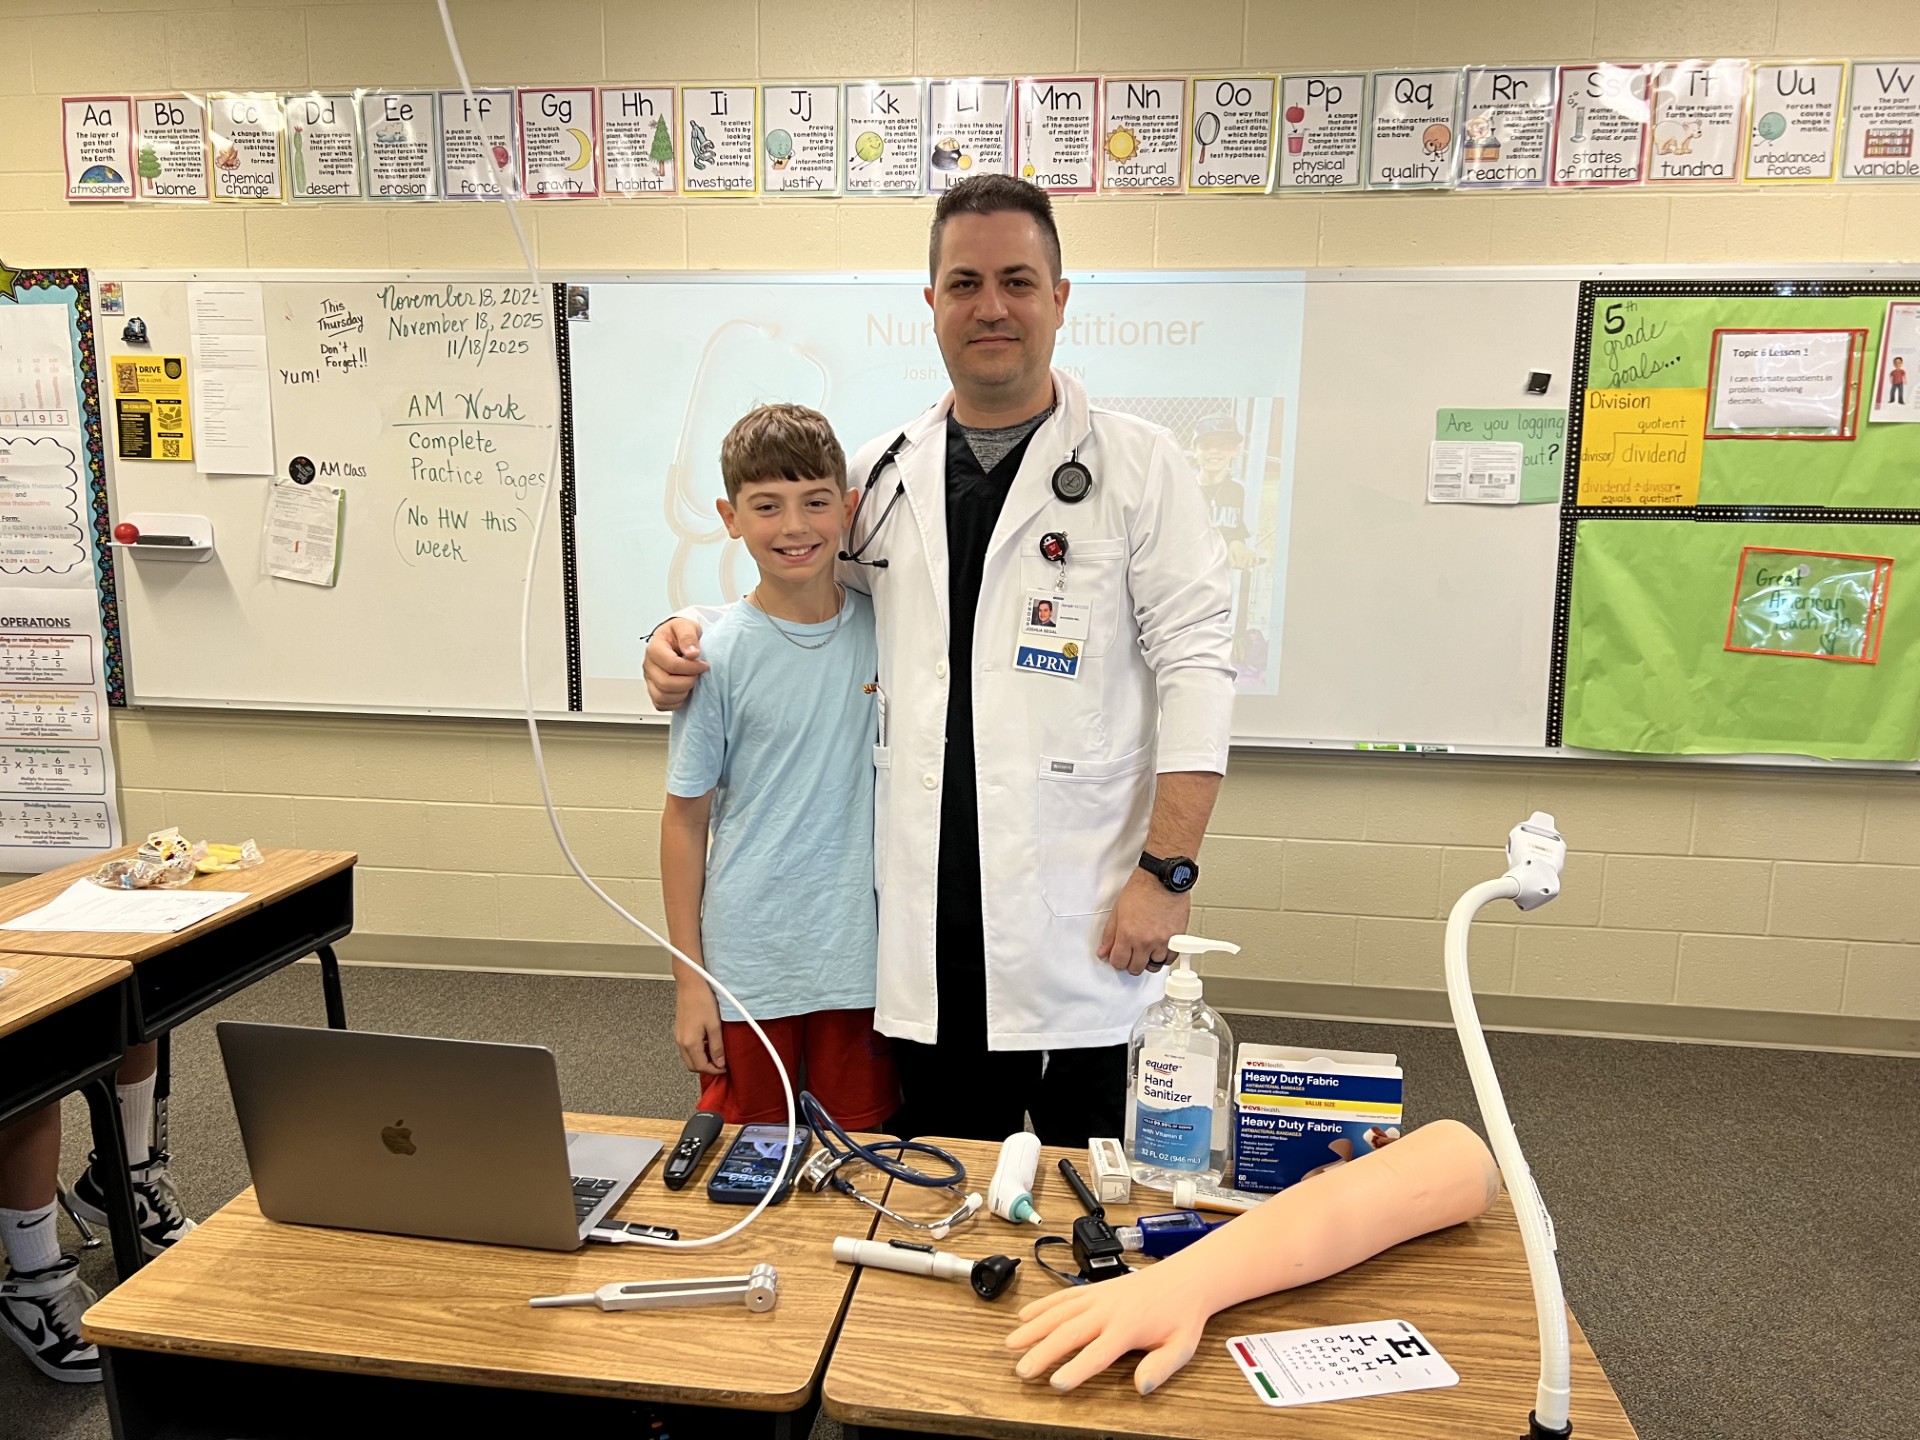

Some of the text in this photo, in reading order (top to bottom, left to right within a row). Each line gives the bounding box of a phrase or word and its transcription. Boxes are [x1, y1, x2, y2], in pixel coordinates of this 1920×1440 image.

[1492, 74, 1528, 100] Rr
[1686, 70, 1718, 97] Tt
[1777, 69, 1815, 96] Uu
[1876, 67, 1915, 93] Vv
[871, 89, 900, 114] Kk
[957, 87, 979, 112] Ll
[1031, 85, 1081, 110] Mm
[1127, 84, 1161, 108] Nn
[1216, 82, 1251, 106] Oo
[1307, 80, 1342, 112] Pp
[1395, 78, 1434, 109] Qq
[384, 98, 414, 121] Ee
[541, 93, 572, 124] Gg
[622, 92, 653, 116] Hh
[710, 91, 728, 115] Ii
[790, 91, 812, 122] Jj
[83, 104, 112, 126] Aa
[155, 102, 185, 126] Bb
[231, 101, 258, 124] Cc
[306, 101, 335, 125] Dd
[1572, 150, 1622, 164] states
[1754, 151, 1826, 164] unbalanced
[1117, 162, 1167, 175] natural
[1293, 158, 1345, 174] physical
[1382, 163, 1439, 182] quality
[1467, 165, 1537, 180] reaction
[1557, 165, 1637, 179] of matter
[1661, 161, 1724, 176] tundra
[1767, 164, 1811, 175] forces
[221, 172, 275, 184] chemical
[461, 180, 500, 193] force
[536, 178, 583, 194] gravity
[616, 177, 664, 191] habitat
[687, 176, 753, 190] investigate
[780, 176, 823, 191] justify
[850, 178, 917, 190] kinetic energy
[1035, 173, 1078, 185] mass
[1108, 176, 1175, 187] resources
[1198, 171, 1260, 185] observe
[1295, 173, 1343, 186] change
[70, 184, 130, 196] atmosphere
[155, 181, 197, 195] biome
[225, 183, 269, 198] change
[306, 182, 350, 194] desert
[380, 183, 426, 194] erosion
[376, 284, 476, 311] November
[320, 299, 345, 314] This
[316, 311, 364, 333] Thursday
[388, 312, 469, 341] November
[500, 312, 544, 330] 2025
[866, 312, 934, 346] Nur
[320, 341, 348, 354] Don't
[447, 329, 529, 367] 11/18/2025
[1604, 316, 1668, 371] grade
[1733, 349, 1758, 358] Topic
[1769, 348, 1801, 357] Lesson
[139, 366, 161, 374] DRIVE
[279, 369, 320, 384] Yum!
[903, 366, 937, 380] Josh
[1768, 386, 1804, 394] involving
[408, 388, 526, 421] AM Work
[1590, 391, 1651, 409] Division
[1445, 413, 1565, 440] Are you logging
[1638, 416, 1686, 434] quotient
[408, 429, 497, 456] Complete
[1523, 443, 1560, 466] out?
[1621, 440, 1688, 463] dividend
[319, 461, 341, 477] AM
[343, 461, 367, 477] Class
[411, 457, 546, 500] Practice Pages
[1581, 476, 1632, 493] dividend
[1601, 492, 1683, 505] equals quotient
[438, 507, 469, 529] HW
[416, 539, 468, 562] week
[0, 617, 71, 627] OPERATIONS
[1022, 652, 1072, 673] APRN
[1145, 1059, 1179, 1072] equate
[1145, 1073, 1173, 1088] Hand
[1245, 1072, 1340, 1087] Heavy Duty Fabric
[1144, 1086, 1192, 1103] Sanitizer
[1241, 1116, 1343, 1133] Heavy Duty Fabric
[1155, 1130, 1178, 1139] Vitamin
[1149, 1150, 1158, 1158] FL
[1159, 1153, 1169, 1161] OZ
[1170, 1155, 1186, 1163] (946
[1385, 1335, 1431, 1358] E
